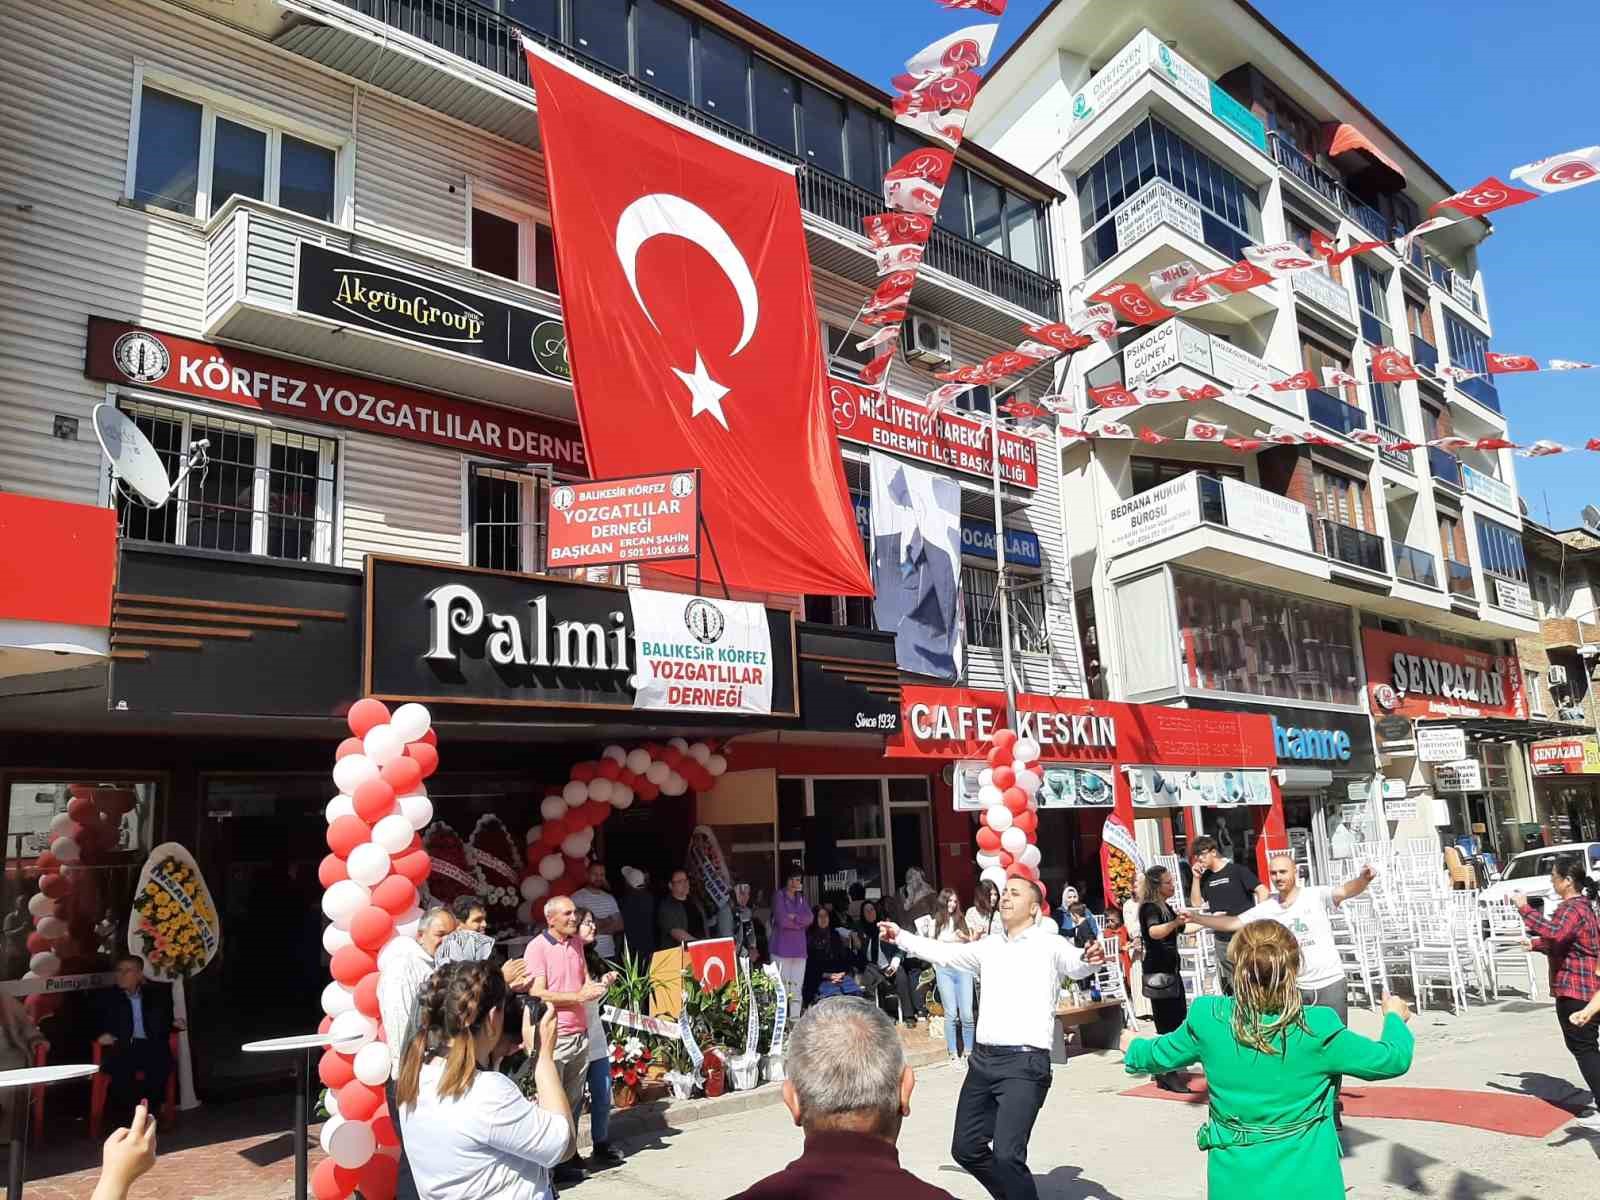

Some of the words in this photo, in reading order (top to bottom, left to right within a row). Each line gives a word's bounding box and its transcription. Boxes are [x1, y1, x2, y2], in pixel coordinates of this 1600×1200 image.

[336, 275, 481, 338] AkgünGroup
[180, 354, 308, 409] KÖRFEZ
[314, 384, 502, 449] YOZGATLILAR
[508, 427, 585, 465] DERNE
[872, 427, 928, 456] EDREMİT
[960, 452, 1026, 482] BAŞKNLIĞI
[998, 436, 1035, 465] ARTİSİ
[579, 486, 626, 502] BALIKESİR
[629, 483, 666, 497] KÖRFEZ
[564, 499, 680, 525] YOZGATLILAR
[592, 518, 652, 538] DERNEĞİ
[551, 543, 613, 560] BAŞKAN
[620, 536, 654, 548] ERCAN
[628, 548, 645, 557] 501
[647, 546, 663, 555] 101
[962, 528, 1036, 559] OCALARI
[425, 584, 636, 672] Palmi
[718, 645, 767, 666] KÖRFEZ
[650, 660, 763, 685] YOZGATLILAR
[668, 685, 743, 707] DERNEĞİ
[855, 712, 877, 728] Since
[878, 713, 897, 729] 1932
[912, 704, 993, 742] CAFE
